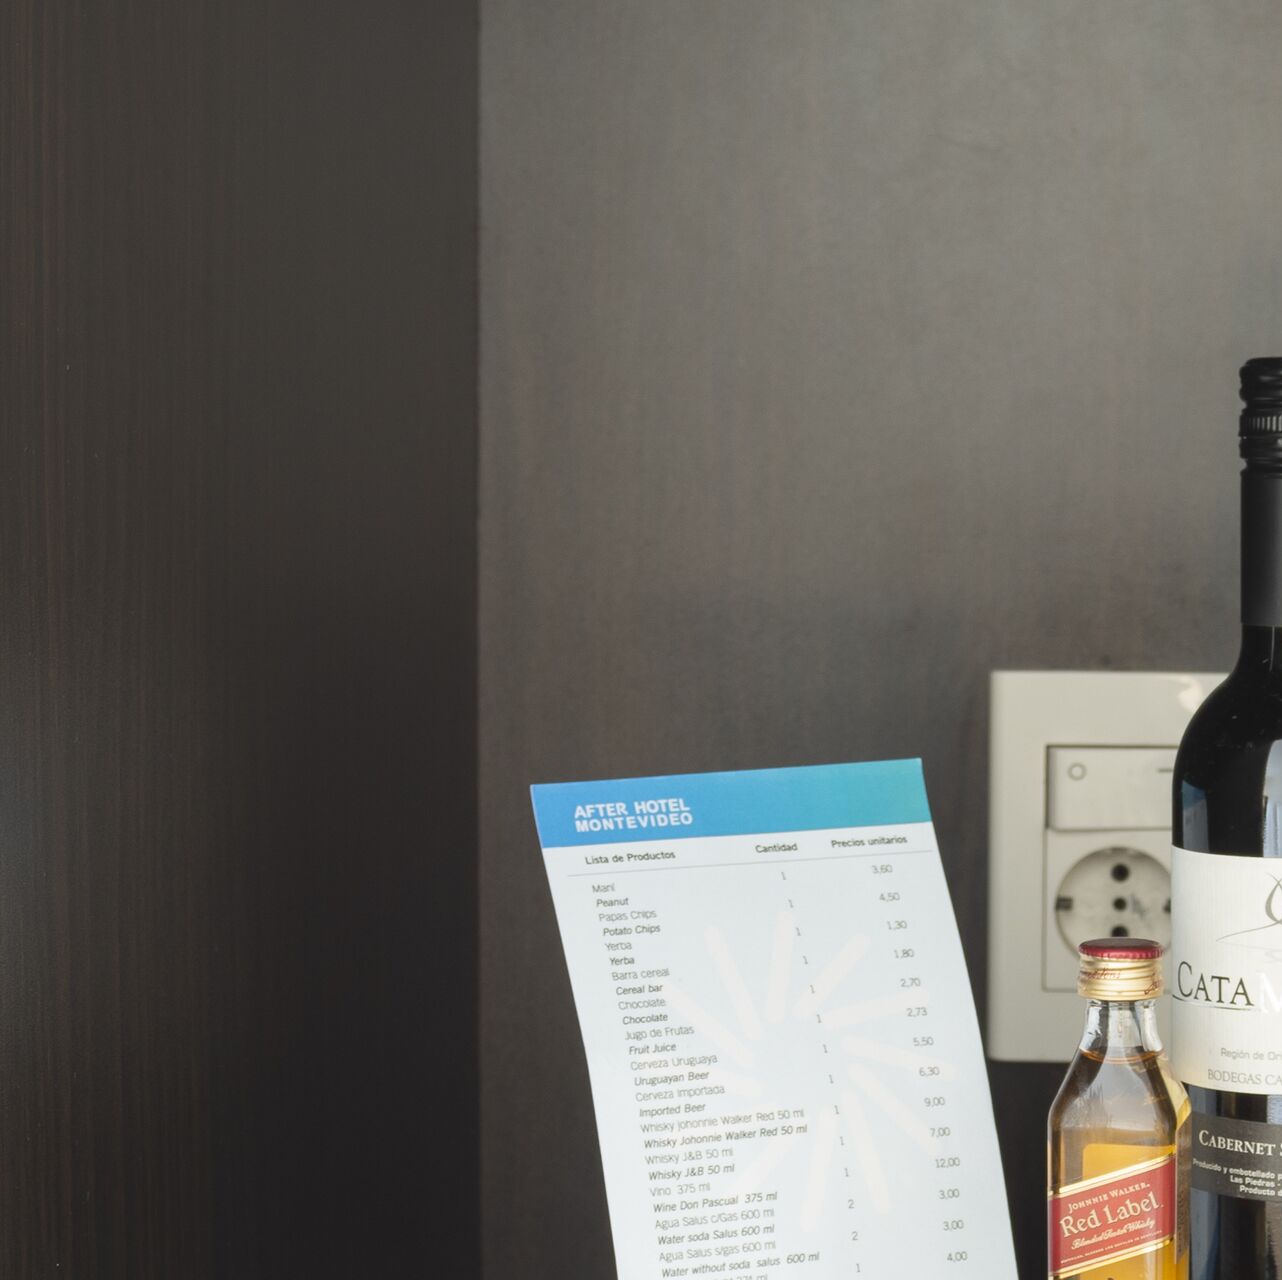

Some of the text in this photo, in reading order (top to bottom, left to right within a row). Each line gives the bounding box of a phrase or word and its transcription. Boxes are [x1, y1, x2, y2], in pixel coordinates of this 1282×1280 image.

[574, 798, 690, 819] AFTER HOTEL
[574, 812, 693, 833] MONTEVIDEO
[755, 843, 798, 854] Cantidad
[830, 836, 908, 848] Precios unitarios
[584, 851, 676, 865] Lista de Productos
[596, 897, 629, 908] Peanut
[602, 923, 661, 937] Potato Chips
[609, 955, 635, 966] Yerba
[615, 984, 664, 996] Cereal bar
[622, 1012, 669, 1026] Chocolate
[628, 1043, 677, 1056] Fruit Juice
[1221, 1048, 1250, 1060] Región
[1253, 1051, 1264, 1061] de
[634, 1070, 710, 1087] Uruguayan Beer
[1208, 1069, 1262, 1085] BODEGAS
[639, 1103, 706, 1119] Imported Beer
[644, 1124, 808, 1151] Whisky Johonnie Walker Red 50 ml
[1199, 1129, 1276, 1157] CABERNET
[648, 1163, 735, 1181] Whisky J&B 50 ml
[1229, 1167, 1275, 1180] embotellado
[1230, 1176, 1275, 1188] Las Piedras
[1239, 1185, 1276, 1196] Producto
[653, 1191, 778, 1213] Wine Don Pascual 375 ml
[1068, 1193, 1109, 1214] JOHNNIE
[1060, 1209, 1102, 1238] Red
[657, 1224, 775, 1246] Water soda Salus 600 ml
[661, 1251, 820, 1278] Water without soda salus 600 ml
